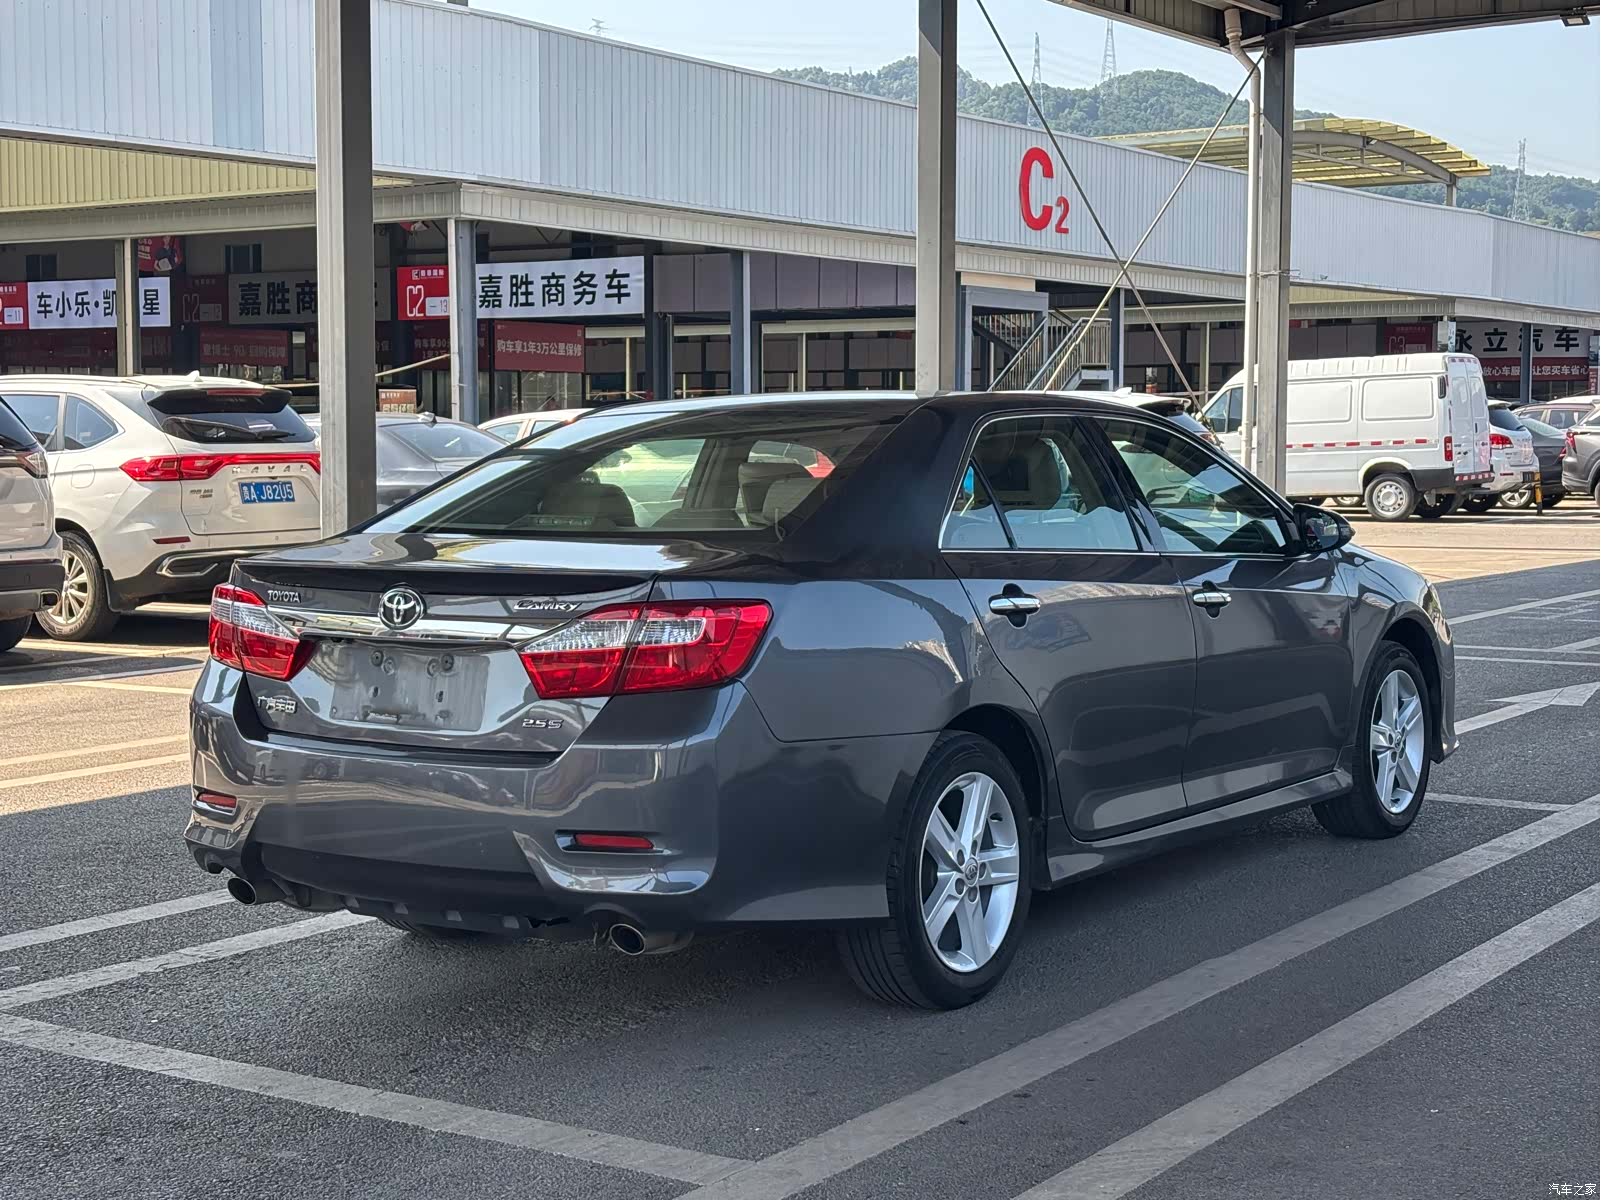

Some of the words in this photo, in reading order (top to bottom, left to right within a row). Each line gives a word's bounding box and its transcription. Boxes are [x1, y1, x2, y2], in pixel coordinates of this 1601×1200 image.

[1018, 146, 1070, 235] C2
[36, 288, 160, 319] 车小乐·凯星
[406, 284, 425, 317] C2
[478, 268, 632, 310] 嘉胜商务车
[496, 339, 582, 357] 购车享1年3万公里保修
[267, 590, 301, 603] TOYOTA
[514, 600, 579, 612] CAMRY
